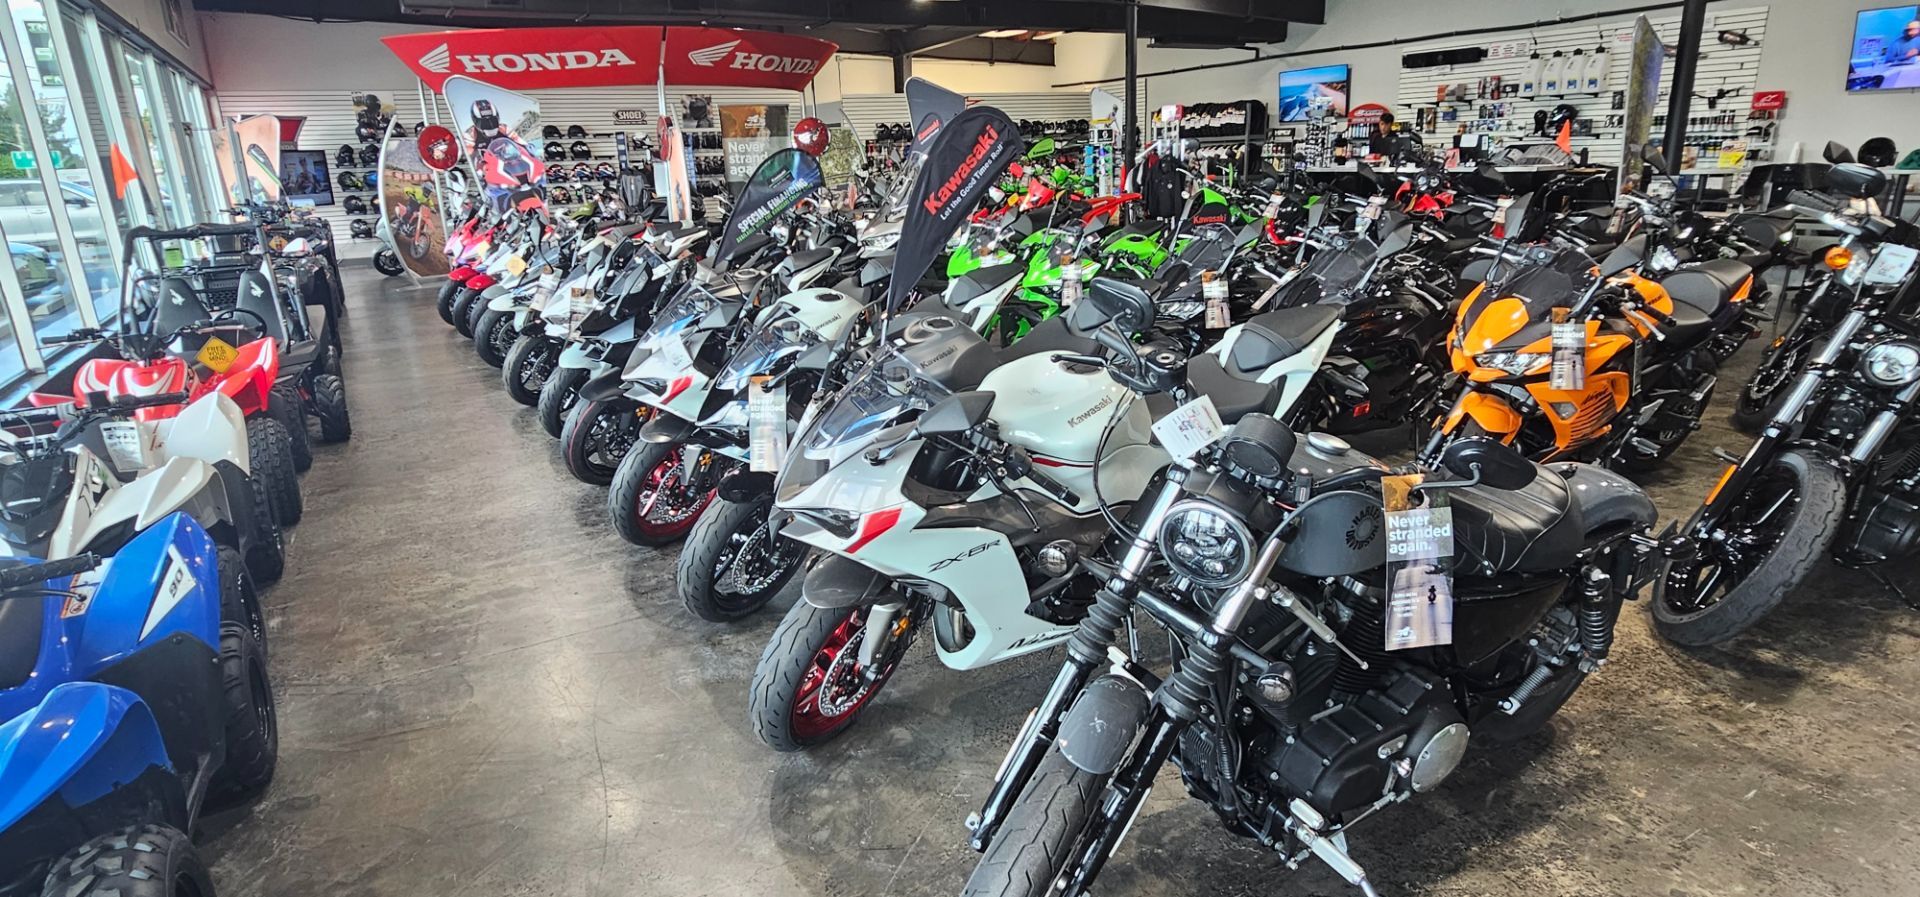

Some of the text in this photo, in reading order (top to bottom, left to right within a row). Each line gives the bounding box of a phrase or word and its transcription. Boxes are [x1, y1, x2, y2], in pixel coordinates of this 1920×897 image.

[455, 49, 636, 73] HONDA
[729, 51, 820, 74] HONDA
[618, 111, 642, 120] SHOEI
[728, 142, 765, 154] Never
[729, 152, 768, 164] strand
[730, 165, 752, 176] aga
[924, 124, 998, 215] Kawasaki
[940, 143, 1004, 220] Let the Good Times Roll
[737, 205, 770, 233] SPECIAL
[767, 178, 808, 210] FINANCING
[920, 344, 958, 369] Kawasaki
[1067, 394, 1113, 428] Kawasaki
[1388, 515, 1430, 529] Never
[1388, 523, 1451, 542] stranded
[928, 539, 1000, 573] ZX-6R
[1389, 540, 1433, 555] again.
[169, 567, 184, 598] 90
